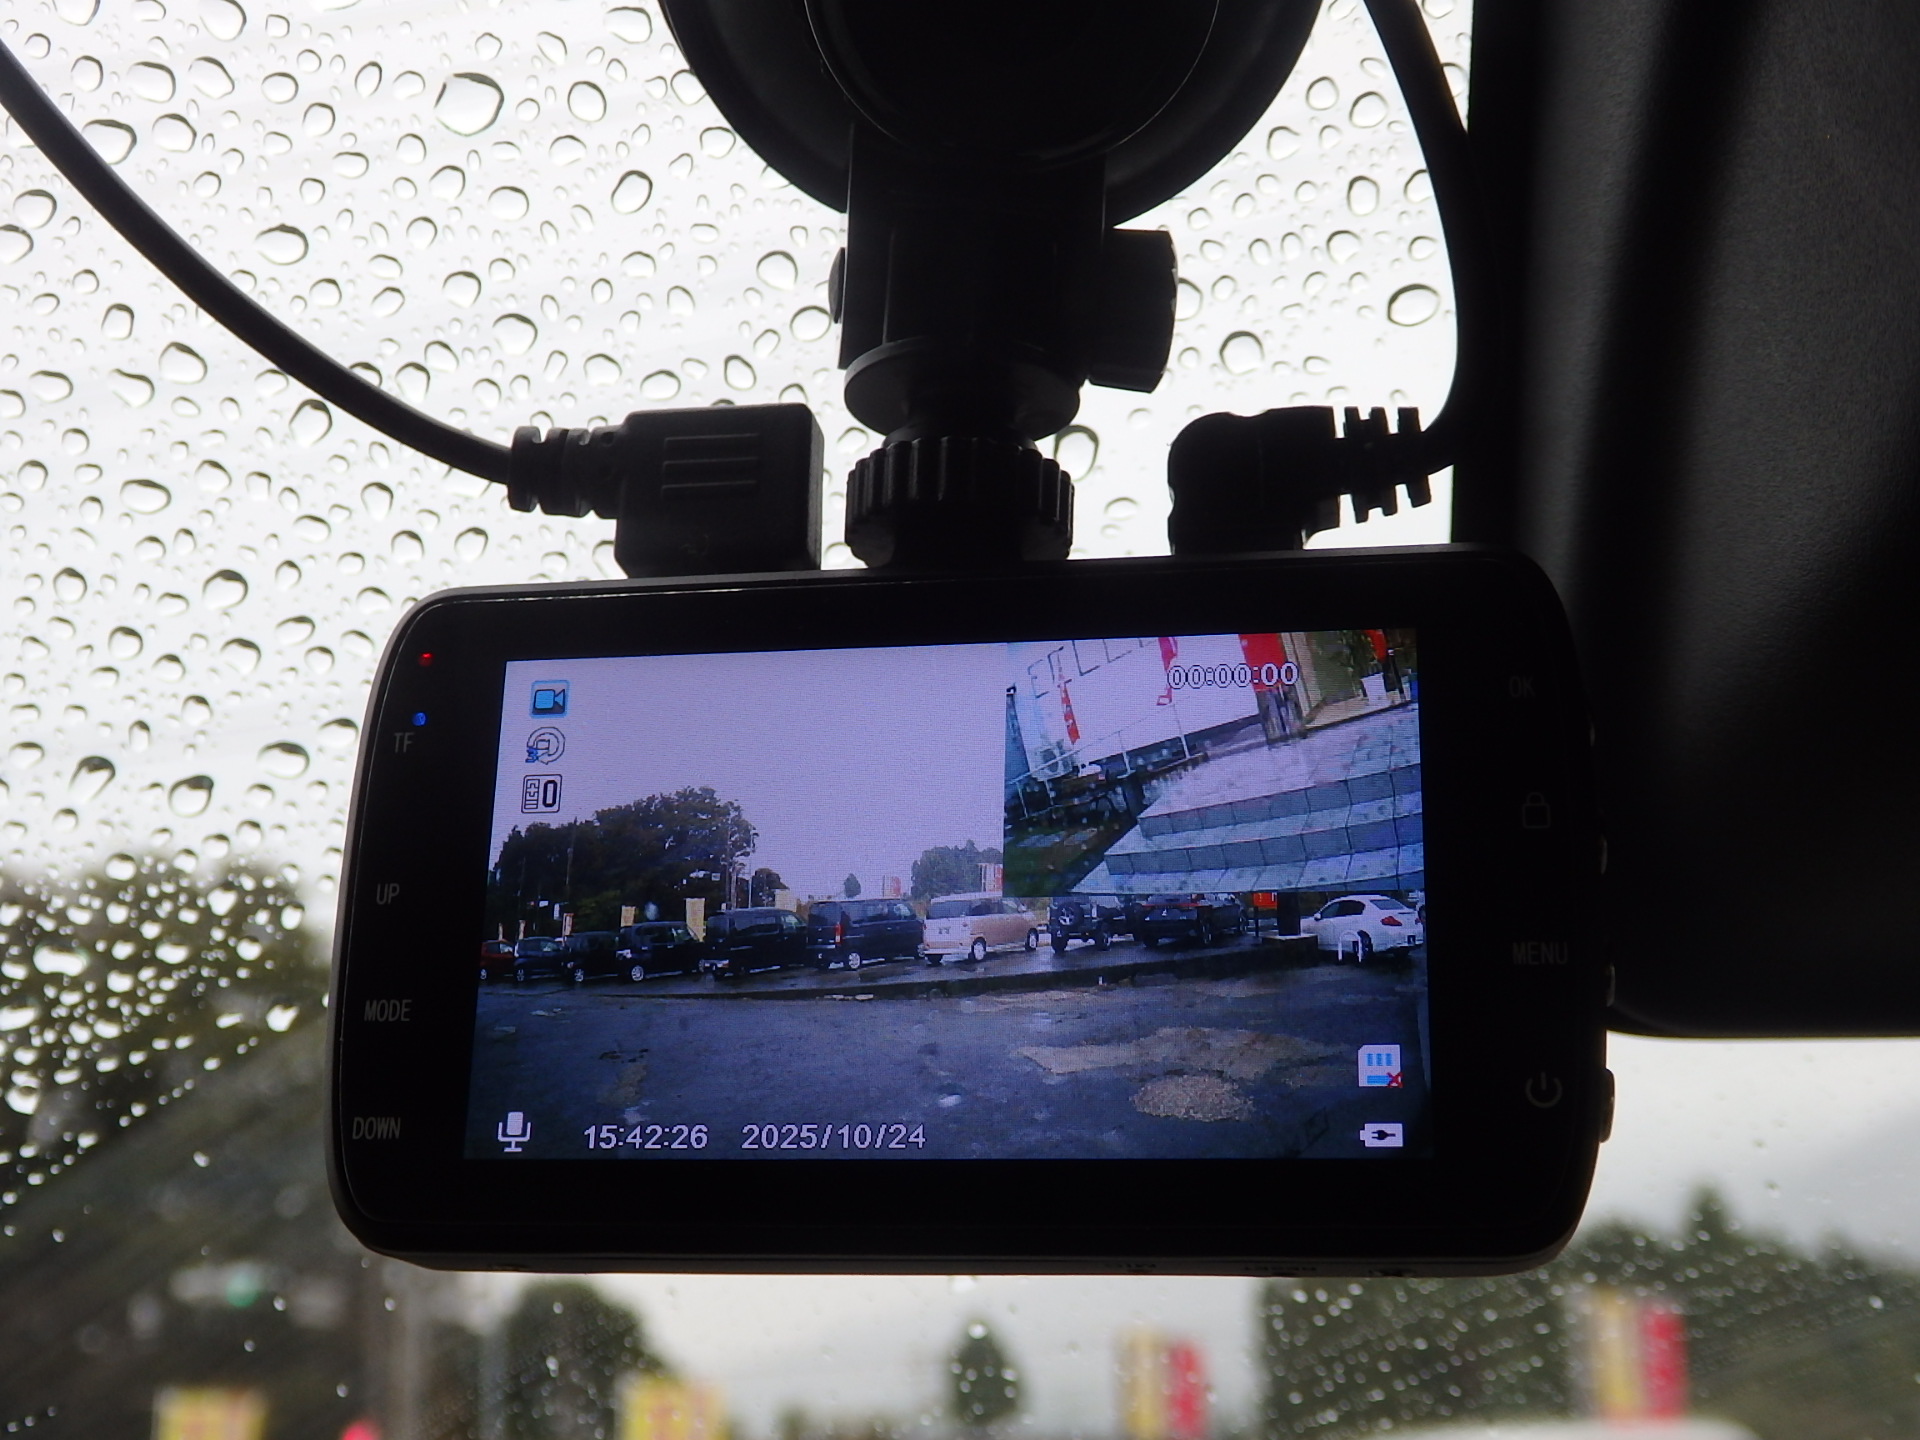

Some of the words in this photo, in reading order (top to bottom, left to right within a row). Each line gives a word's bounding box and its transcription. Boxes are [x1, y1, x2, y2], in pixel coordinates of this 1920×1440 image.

[1167, 661, 1300, 690] 00:00:00
[1508, 675, 1536, 698] OK
[393, 732, 415, 753] TF
[375, 883, 400, 905] UP
[1512, 942, 1569, 965] MENU
[363, 999, 412, 1022] MODE
[352, 1116, 401, 1140] DOWN
[582, 1123, 710, 1150] 15:42:26
[740, 1123, 927, 1150] 2025/10/24
